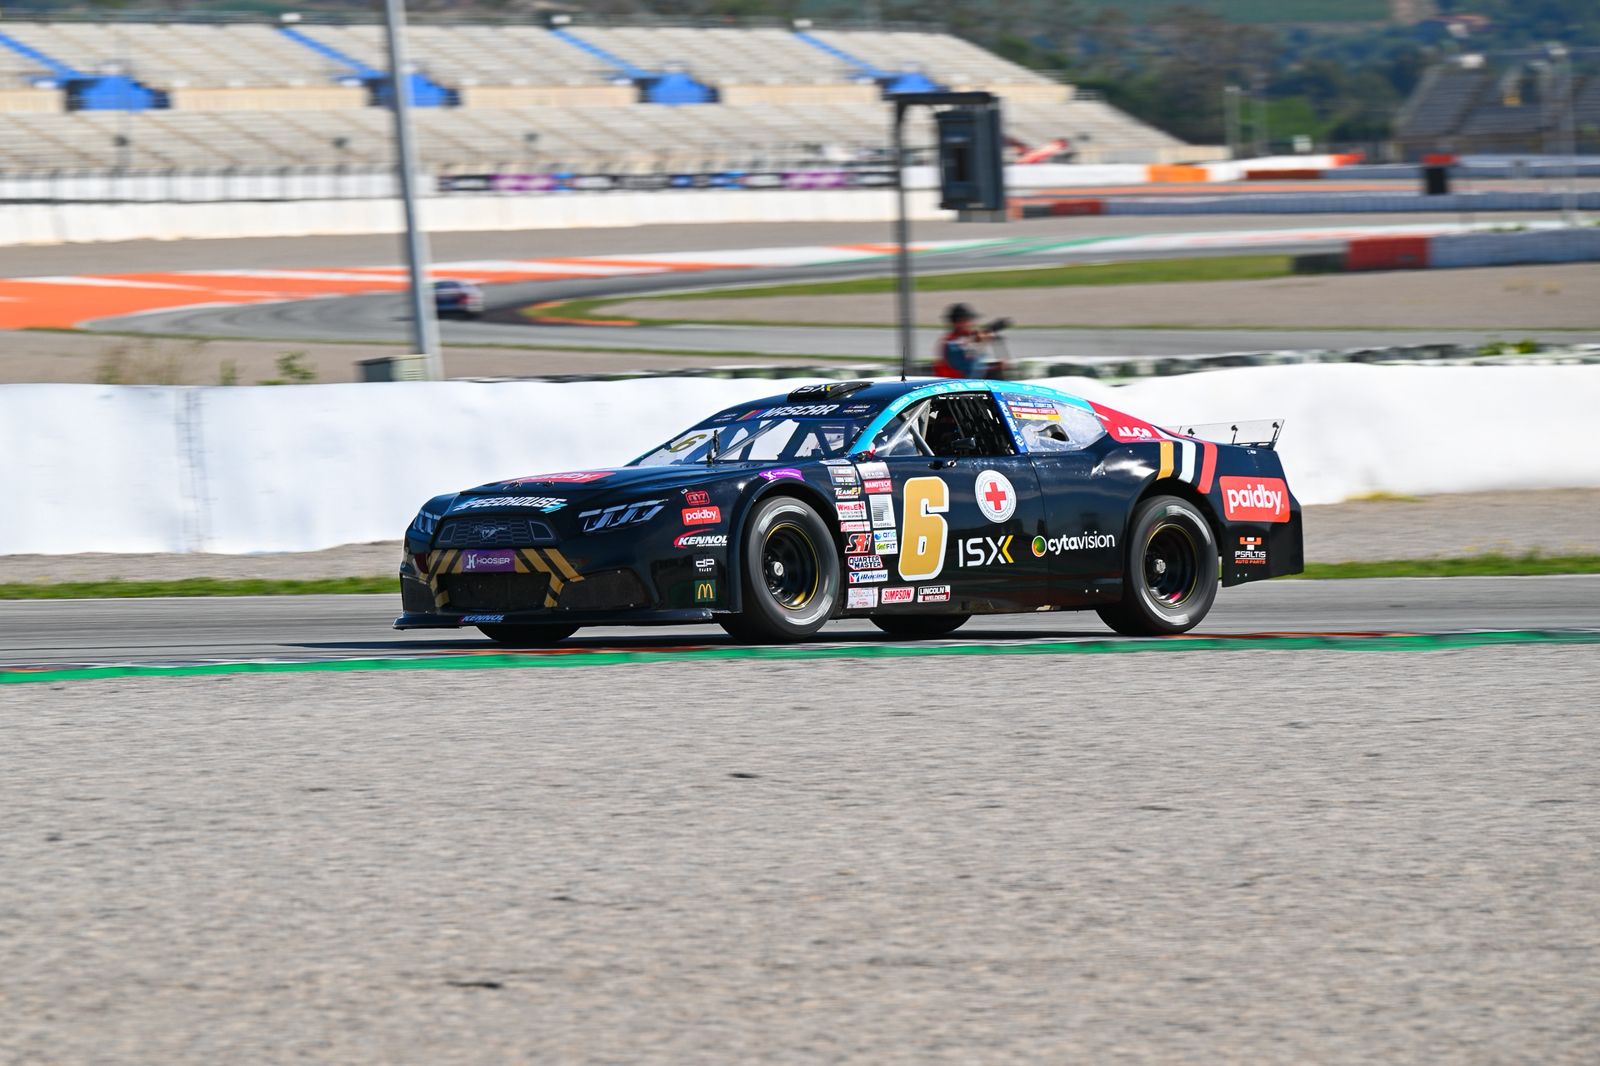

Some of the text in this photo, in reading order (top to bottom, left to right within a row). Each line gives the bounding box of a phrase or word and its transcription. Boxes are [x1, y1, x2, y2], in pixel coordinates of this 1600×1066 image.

[756, 404, 840, 418] NASCAR
[1227, 484, 1282, 515] paidby
[685, 509, 717, 522] paidby
[898, 476, 949, 581] 6
[678, 535, 728, 546] KENNOL
[1047, 531, 1116, 556] cytavision
[958, 534, 1014, 567] ISX
[1234, 550, 1266, 558] PSALTIS
[476, 556, 511, 565] HOOSIER
[848, 555, 880, 565] QUARTER
[854, 561, 881, 570] MASTER
[860, 572, 887, 581] iRacing
[883, 589, 912, 600] SIMPSON
[919, 586, 946, 595] LINCOLN
